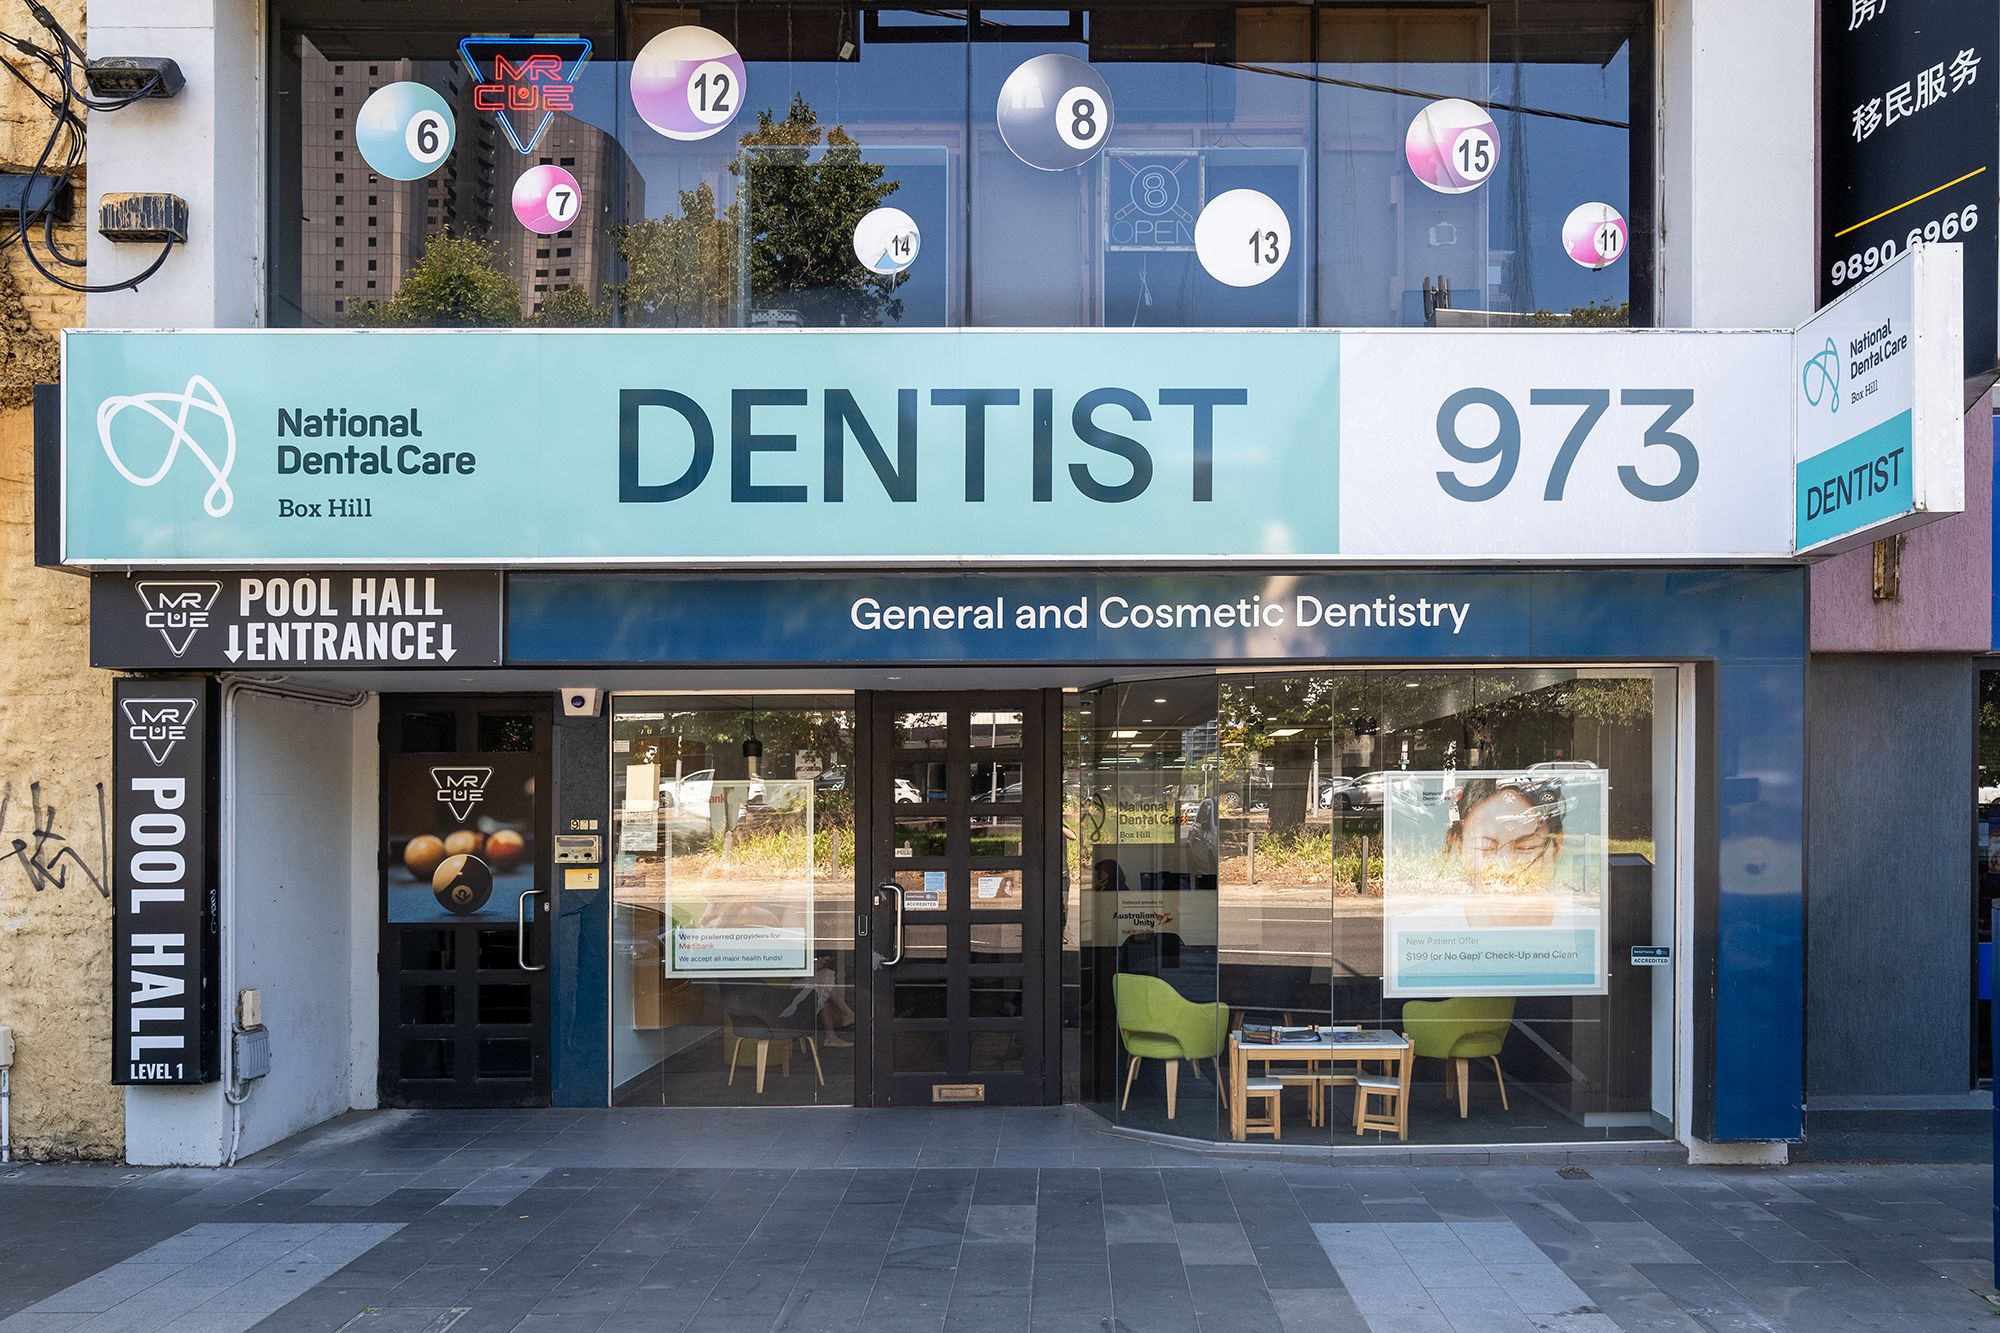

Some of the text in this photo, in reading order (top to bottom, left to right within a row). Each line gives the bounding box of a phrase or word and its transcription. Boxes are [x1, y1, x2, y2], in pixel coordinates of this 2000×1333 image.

[495, 54, 563, 80] MR
[474, 85, 574, 110] CUE
[694, 73, 730, 111] 12
[1852, 47, 1982, 143] 移民服务
[1071, 98, 1096, 141] 8
[417, 118, 439, 154] 6
[1458, 139, 1490, 173] 15
[555, 191, 571, 216] 7
[892, 234, 910, 256] 14
[1249, 230, 1279, 264] 13
[1600, 229, 1617, 251] 11
[1831, 204, 1978, 286] 9890 6966
[1850, 318, 1892, 358] National
[1850, 334, 1907, 380] Dental Care
[1851, 380, 1878, 404] Box Hill
[277, 407, 423, 438] National
[618, 387, 1248, 504] DENTIST
[1435, 387, 1700, 502] 973
[277, 444, 476, 475] Dental Care
[1807, 446, 1904, 521] DENTIST
[278, 498, 373, 518] Box Hill
[159, 592, 202, 609] MR
[240, 577, 443, 617] POOL HALL
[145, 612, 209, 628] CUE
[850, 594, 1471, 635] General and Cosmetic Dentistry
[246, 621, 437, 661] ENTRANCE
[142, 709, 179, 723] MR
[130, 726, 186, 740] CUE
[447, 775, 479, 787] MR
[437, 789, 484, 801] CUE
[1119, 801, 1169, 812] Naional
[1136, 831, 1151, 839] Hill
[130, 777, 186, 1061] POOL HALL
[1133, 919, 1155, 928] Unity
[701, 933, 734, 941] preferred
[736, 932, 769, 941] providers
[1406, 936, 1480, 945] New Patient Offer
[1406, 952, 1429, 961] $199
[1430, 952, 1442, 961] (or
[1444, 952, 1457, 961] No
[1485, 950, 1531, 961] Check-Up
[1533, 950, 1550, 959] and
[1552, 950, 1578, 959] Clean
[130, 1063, 184, 1080] LEVEL 1
